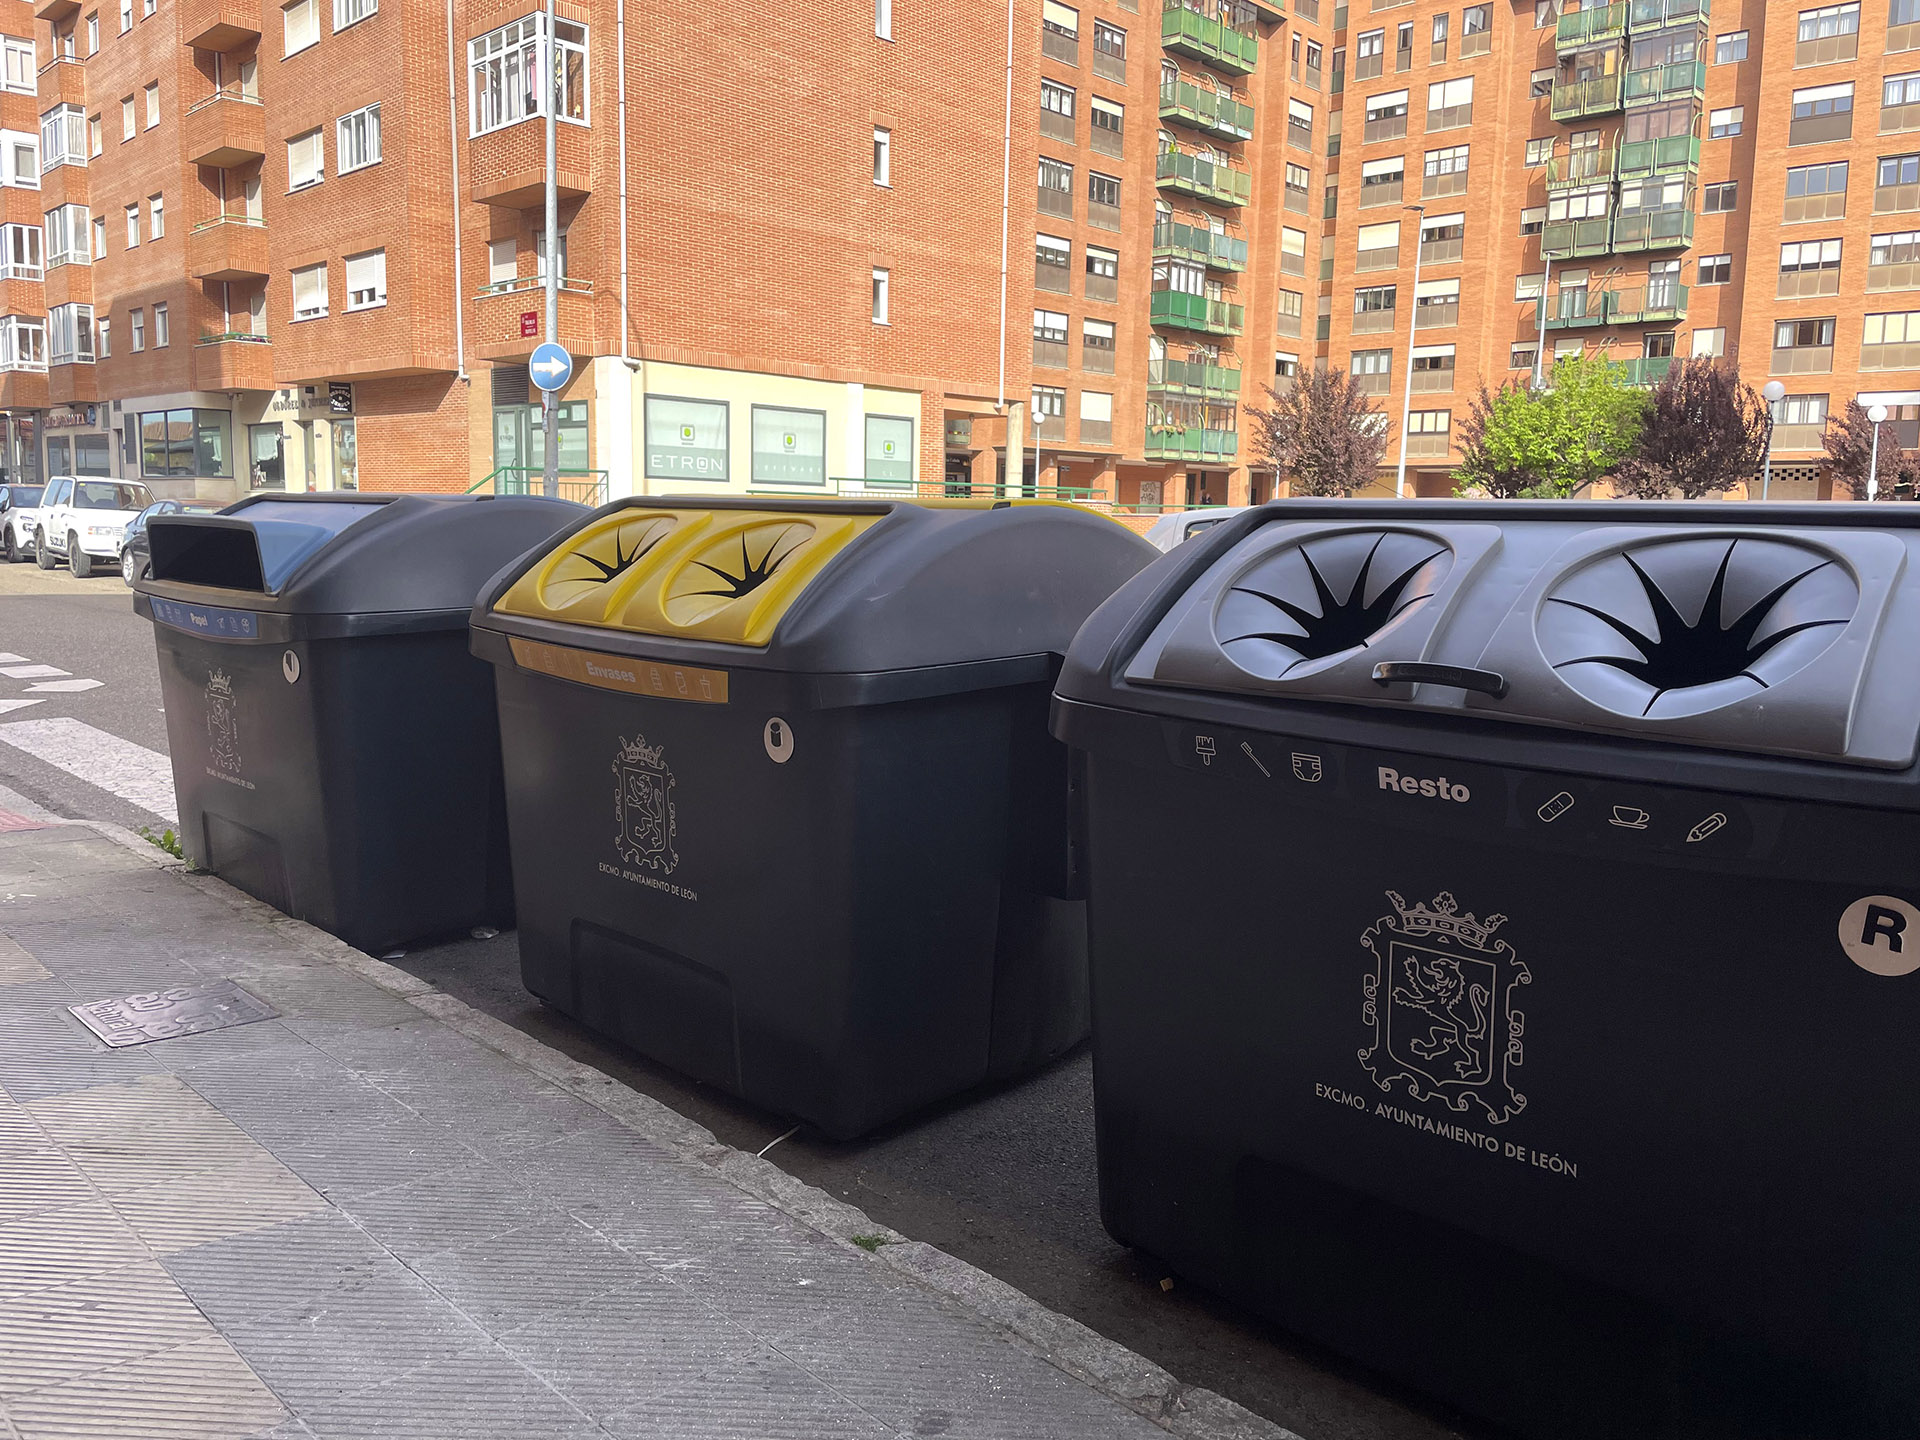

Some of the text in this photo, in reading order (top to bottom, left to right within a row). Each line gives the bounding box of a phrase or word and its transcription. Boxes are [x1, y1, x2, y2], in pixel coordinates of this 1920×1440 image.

[651, 454, 723, 473] ETRON
[190, 612, 208, 627] Papel
[586, 661, 636, 683] Envases
[1378, 766, 1470, 803] Resto
[599, 862, 698, 902] EXCMO. AYUNTAMIENTO DE LEÓN
[1861, 904, 1907, 953] R
[1315, 1083, 1578, 1178] EXCMO. AYUNTAMIENTO DE LEÓN
